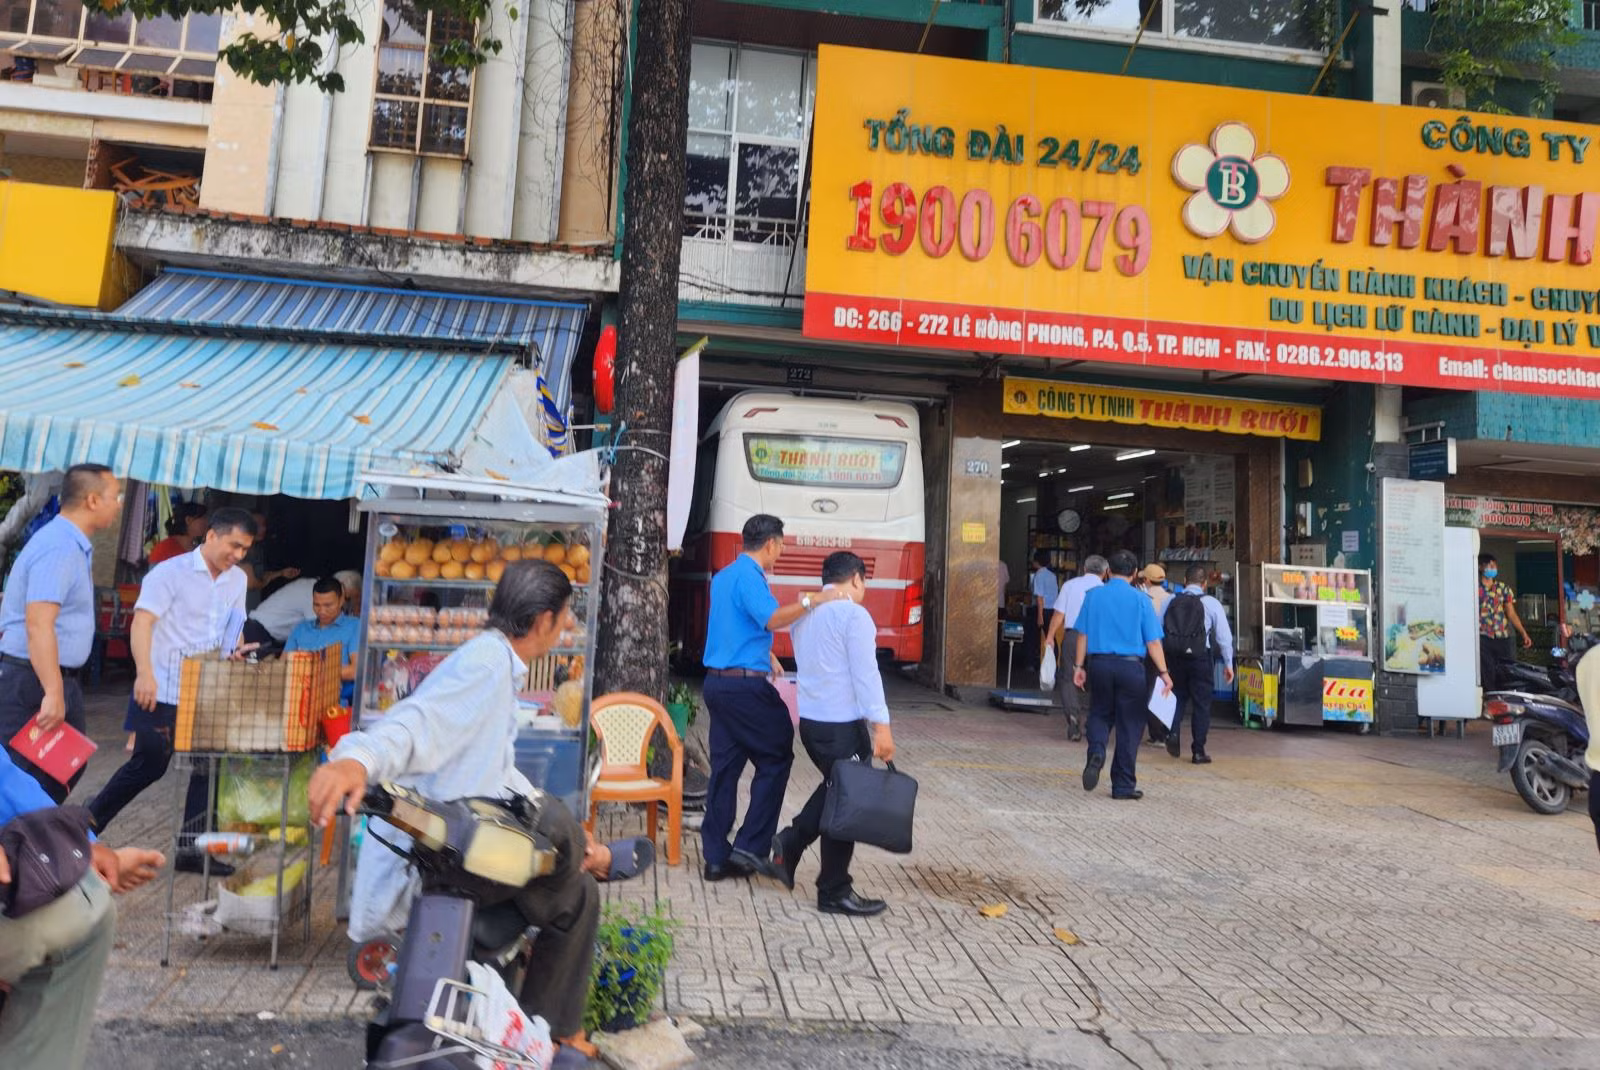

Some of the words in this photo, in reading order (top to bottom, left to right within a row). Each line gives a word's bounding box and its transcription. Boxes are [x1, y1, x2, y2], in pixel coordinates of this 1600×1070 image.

[864, 107, 956, 158] TỔNG
[967, 124, 1025, 165] ĐÀI
[1037, 137, 1142, 176] 24/24
[1422, 115, 1531, 159] CÔNG
[1541, 131, 1591, 165] TY
[847, 179, 996, 262] 1900
[1005, 193, 1153, 278] 6079
[1325, 162, 1600, 266] THÀNH
[1183, 252, 1235, 287] VẬN
[1348, 266, 1416, 299] HÀNH
[1424, 276, 1508, 307] KHÁCH
[834, 306, 864, 329] ĐC:
[867, 308, 903, 332] 266
[917, 313, 949, 336] 272
[953, 313, 971, 338] LÊ
[975, 312, 1023, 342] HỒNG
[1027, 322, 1089, 349] PHONG,
[1122, 330, 1153, 354] Q.5,
[1157, 334, 1179, 355] TP.
[1182, 336, 1221, 359] HCM
[1235, 340, 1271, 363] FAX:
[1276, 344, 1404, 373] 0286.2.908.313
[1270, 297, 1304, 324] DU
[1313, 301, 1368, 332] LỊCH
[1375, 304, 1407, 332] LỮ
[1413, 307, 1480, 338] HÀNH
[1501, 316, 1545, 349] ĐẠI
[1553, 318, 1578, 346] LÝ
[790, 367, 811, 379] 272
[1439, 356, 1489, 379] Email:
[1038, 386, 1076, 413] CÔNG
[1079, 392, 1097, 415] TY
[1099, 394, 1136, 418] TNHH
[1139, 398, 1233, 427] THÀNH
[967, 460, 988, 473] 270
